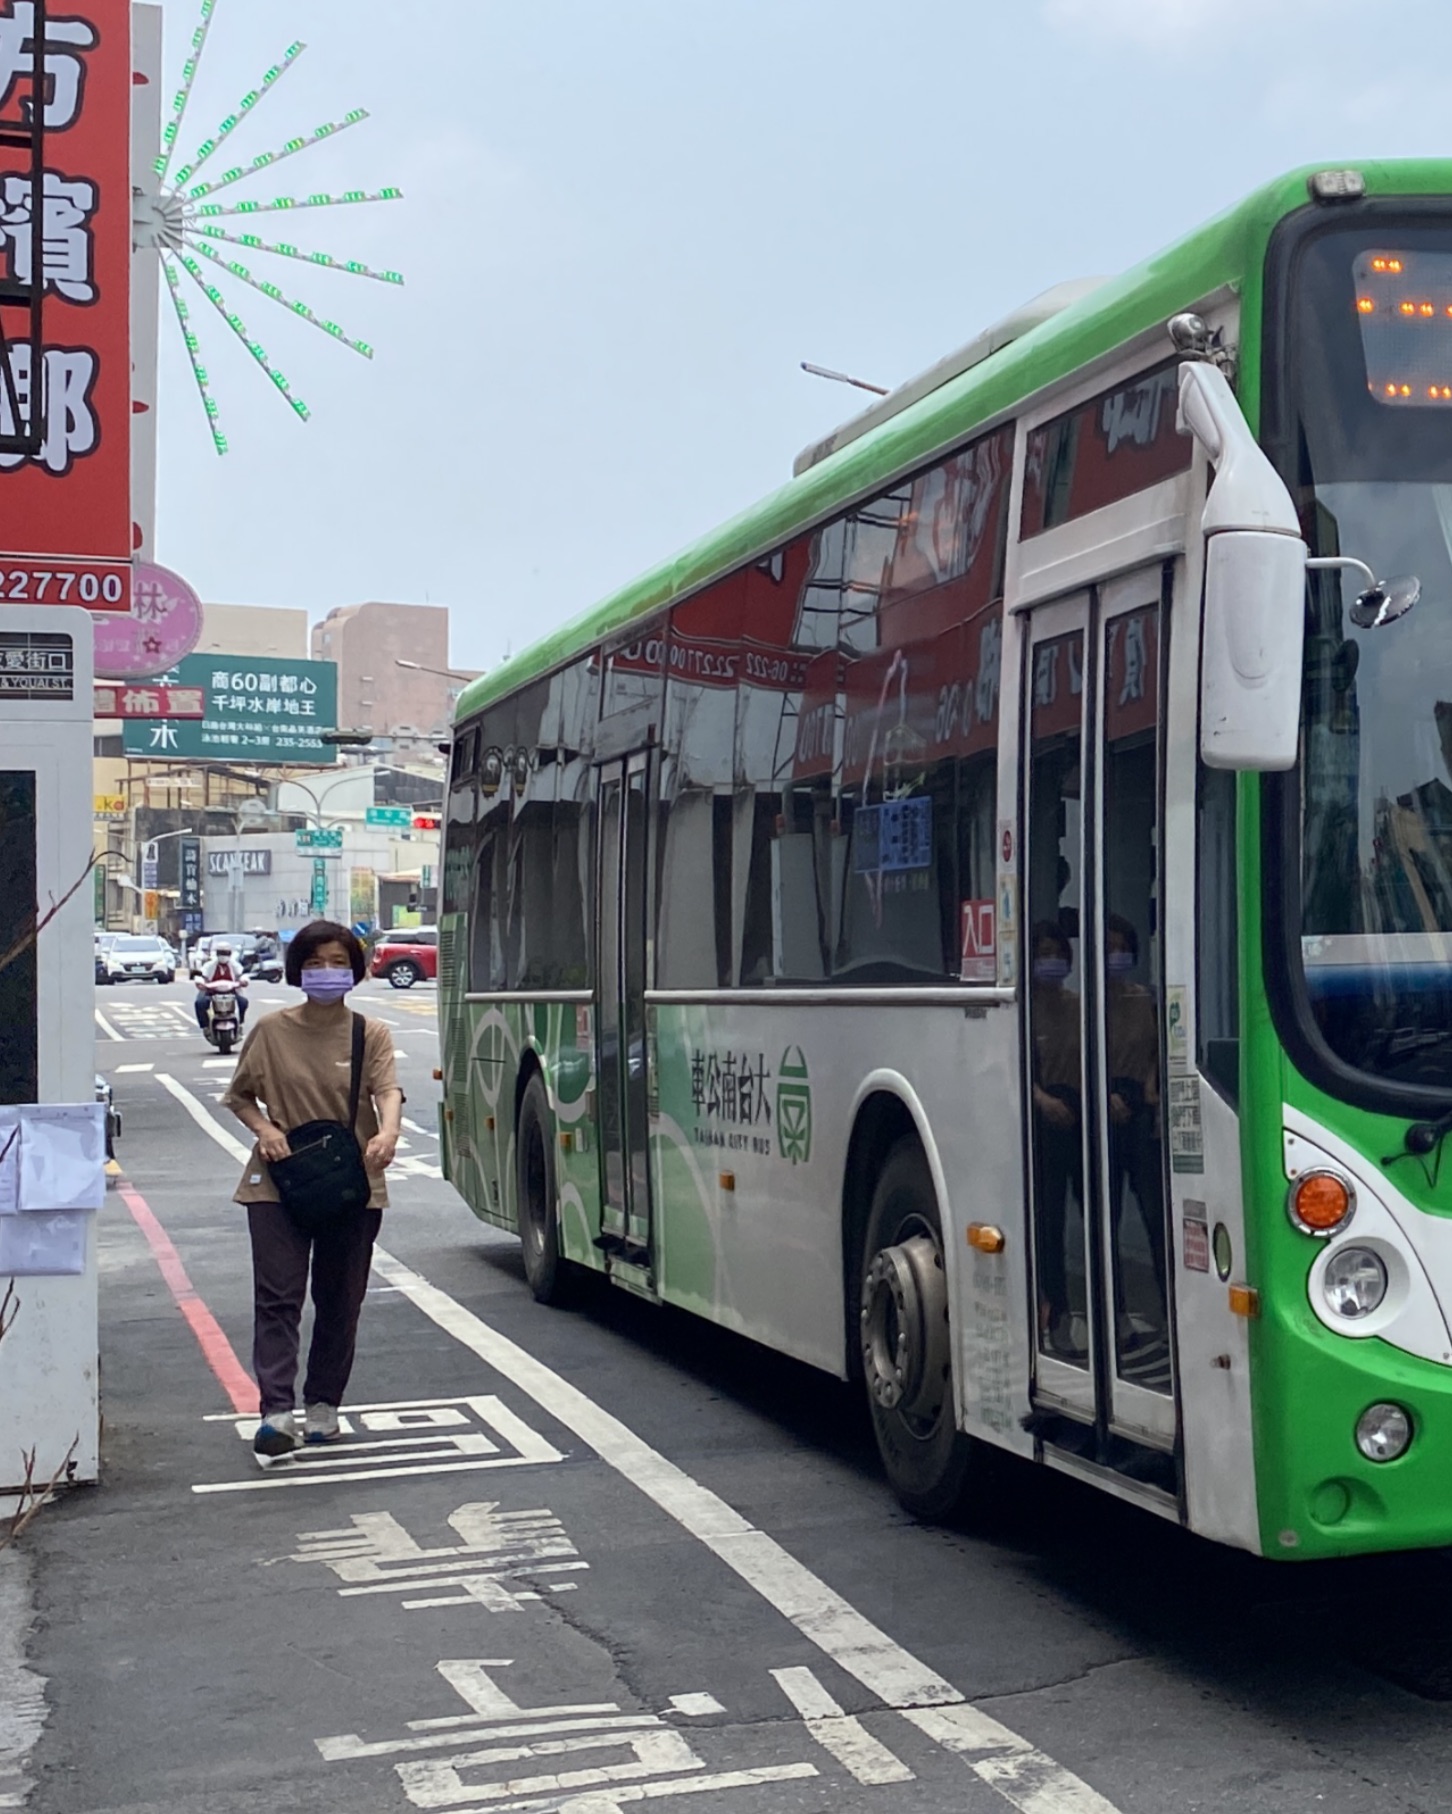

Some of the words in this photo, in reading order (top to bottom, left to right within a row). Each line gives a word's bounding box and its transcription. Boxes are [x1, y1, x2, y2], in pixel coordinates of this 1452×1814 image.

[212, 671, 317, 695] 商60副都心
[212, 694, 316, 716] 千坪水岸地王
[962, 904, 995, 956] 入口
